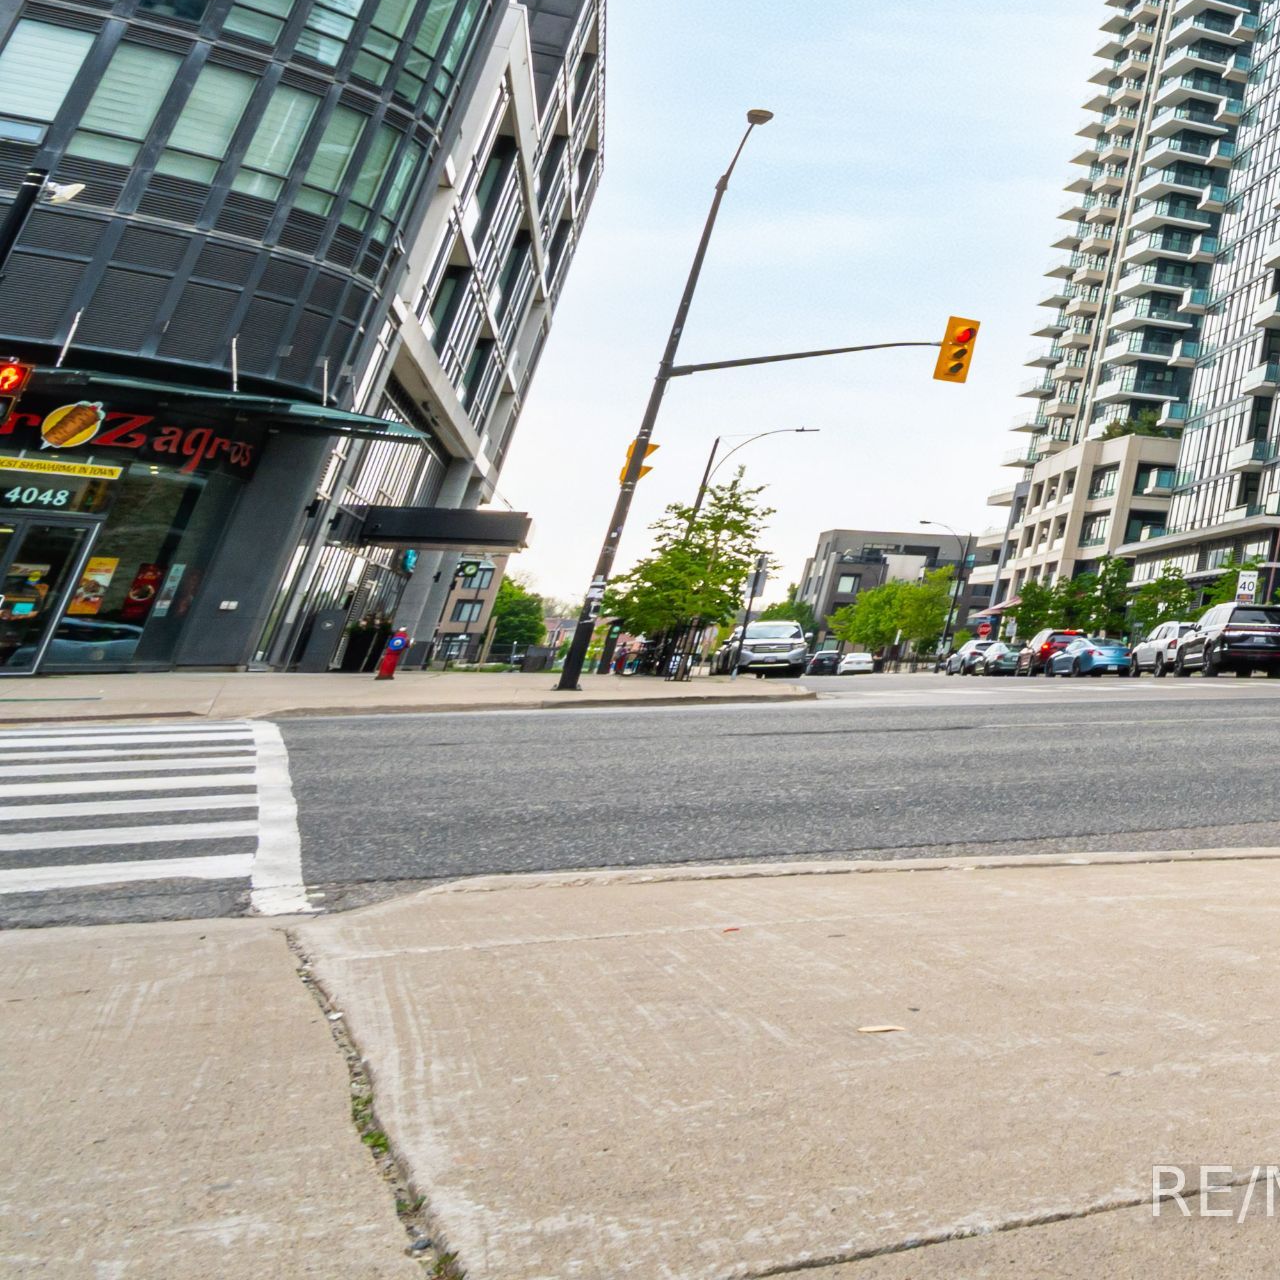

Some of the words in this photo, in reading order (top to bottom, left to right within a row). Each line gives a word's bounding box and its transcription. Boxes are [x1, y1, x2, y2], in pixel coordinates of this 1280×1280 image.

[90, 412, 254, 474] Zagros
[19, 461, 76, 473] SHAWARMA
[79, 466, 87, 474] IN
[89, 467, 115, 476] TOWN
[5, 486, 70, 506] 4048
[1240, 581, 1255, 591] 40
